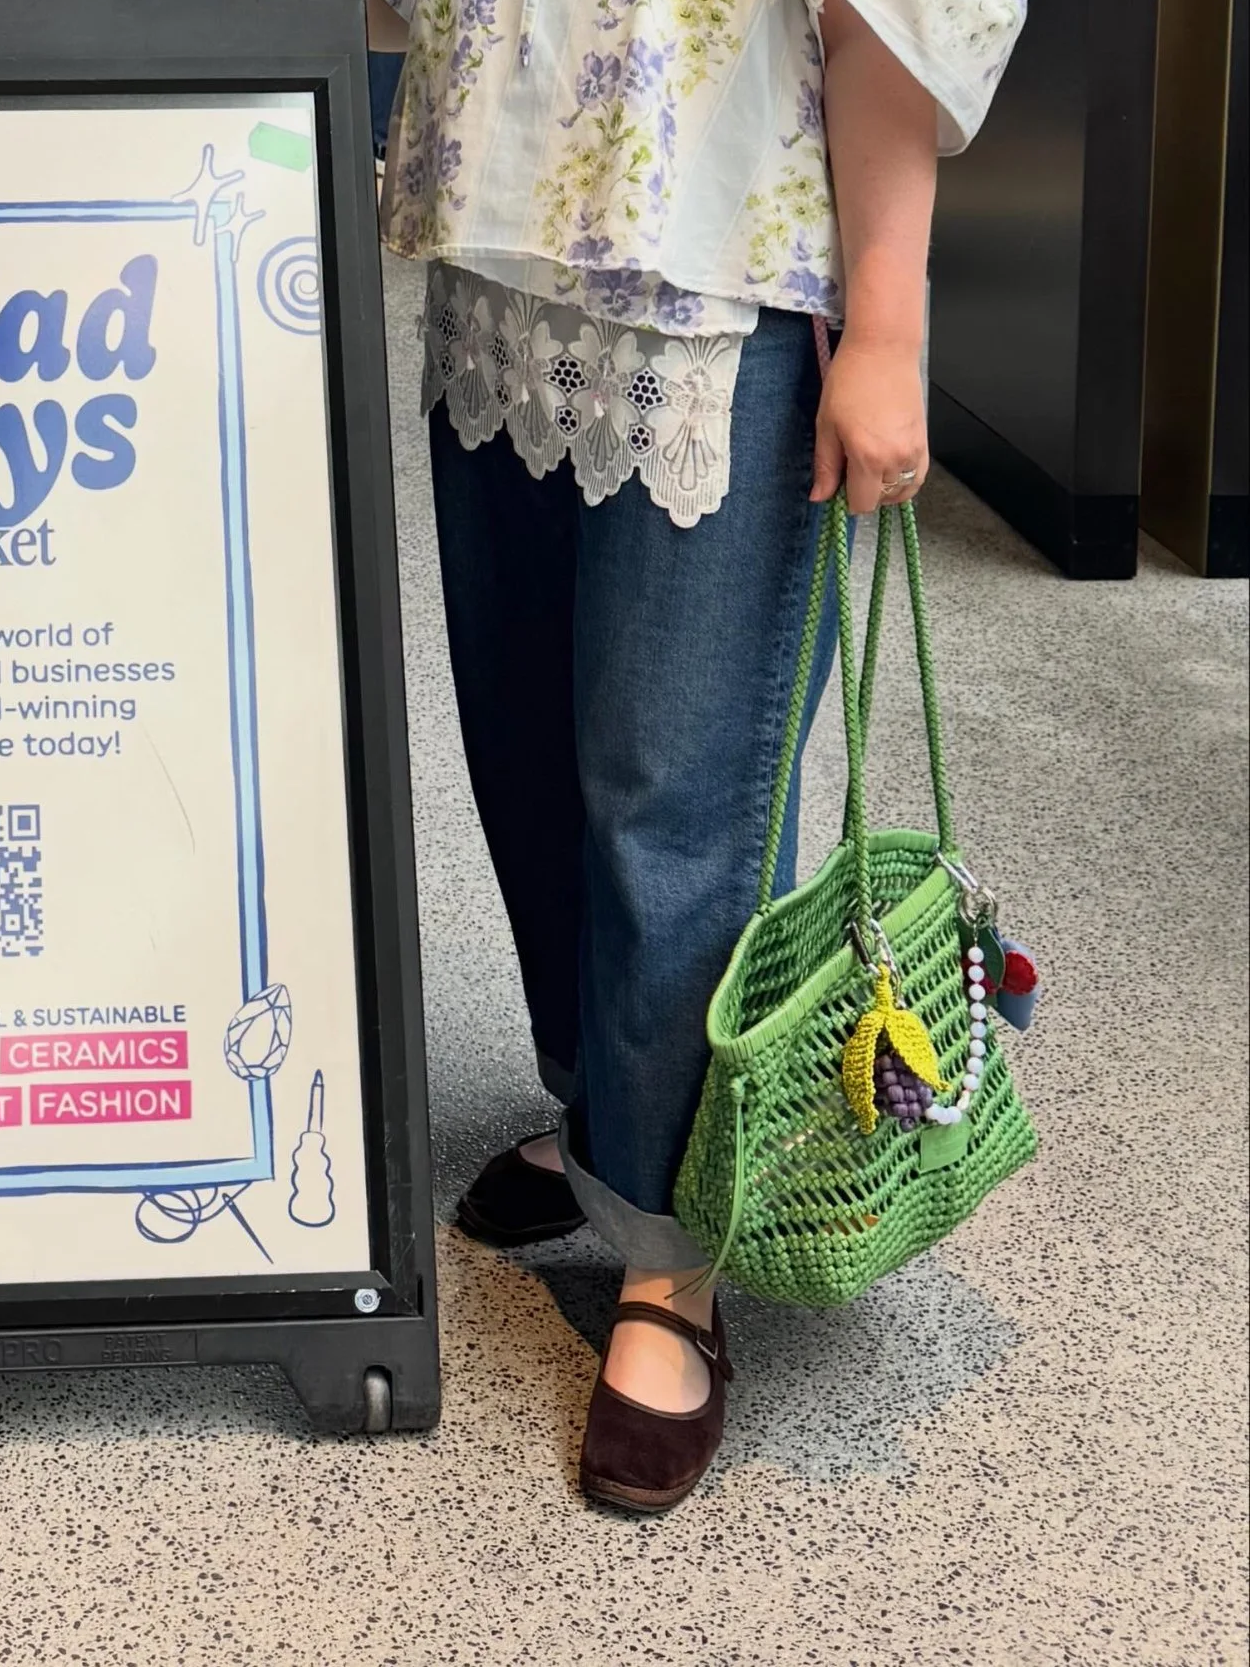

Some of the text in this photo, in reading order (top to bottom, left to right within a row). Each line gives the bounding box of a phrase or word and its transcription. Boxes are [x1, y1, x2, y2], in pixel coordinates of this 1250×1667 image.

[82, 622, 114, 646] of
[12, 659, 175, 684] businesses
[23, 730, 121, 757] today!
[13, 1008, 27, 1027] &
[33, 1005, 186, 1026] SUSTAINABLE
[8, 1037, 178, 1068] CERAMICS
[38, 1088, 181, 1119] FASHION
[104, 1333, 167, 1348] PATENT
[101, 1346, 173, 1364] PENDING
